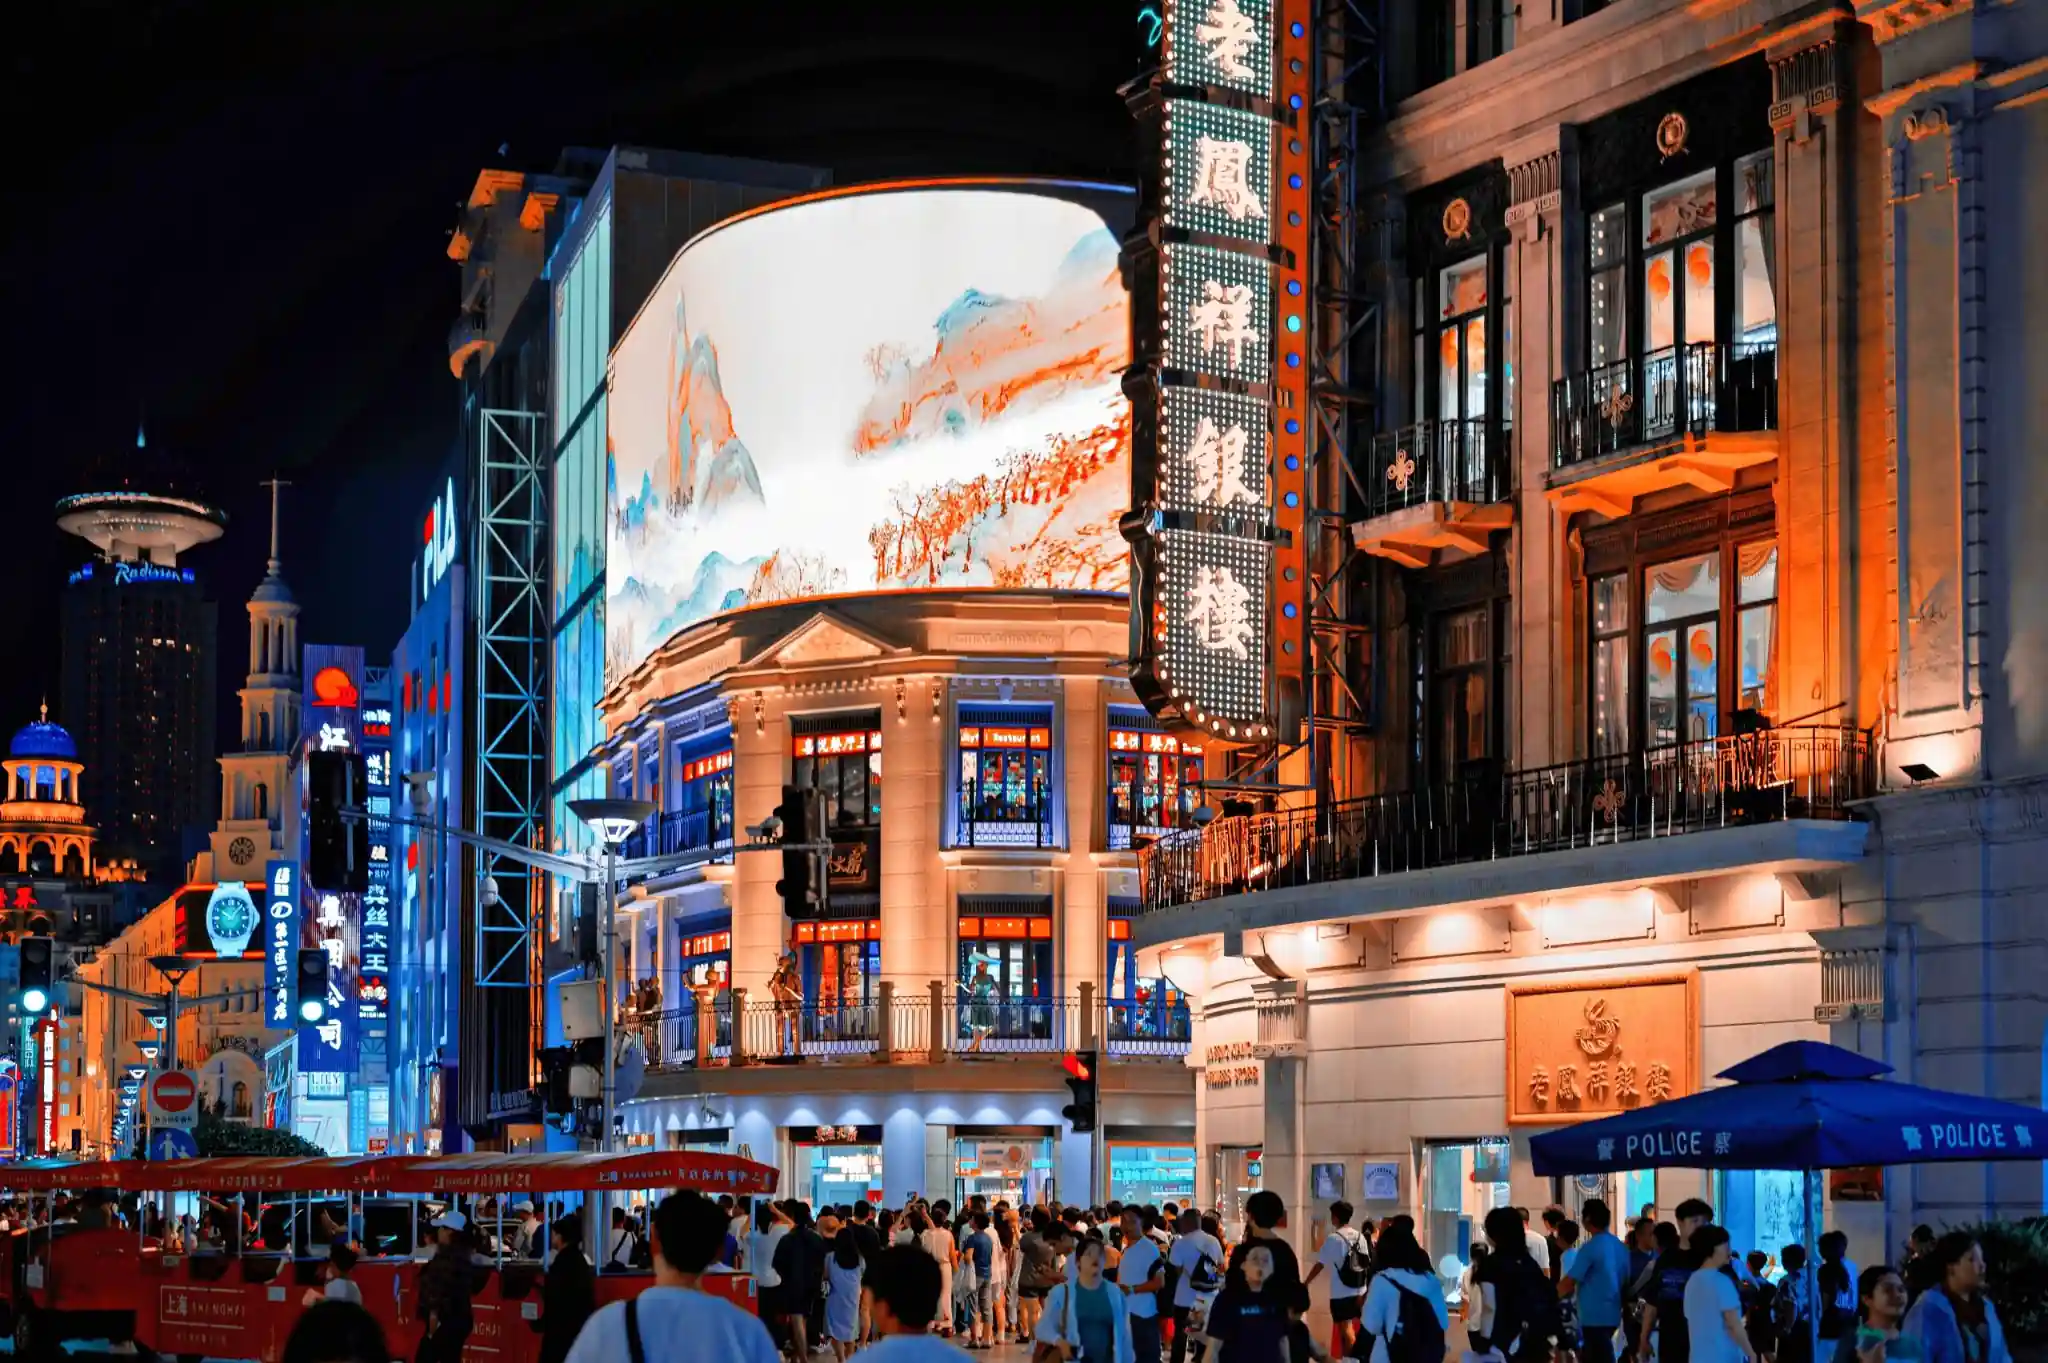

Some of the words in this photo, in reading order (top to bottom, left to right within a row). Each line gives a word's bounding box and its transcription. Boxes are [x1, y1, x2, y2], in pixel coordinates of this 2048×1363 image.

[423, 476, 456, 602] FILA
[115, 562, 181, 586] Radisson
[1626, 1131, 1702, 1160] POLICE
[1930, 1122, 2006, 1149] POLICE
[165, 1292, 188, 1317] 上海
